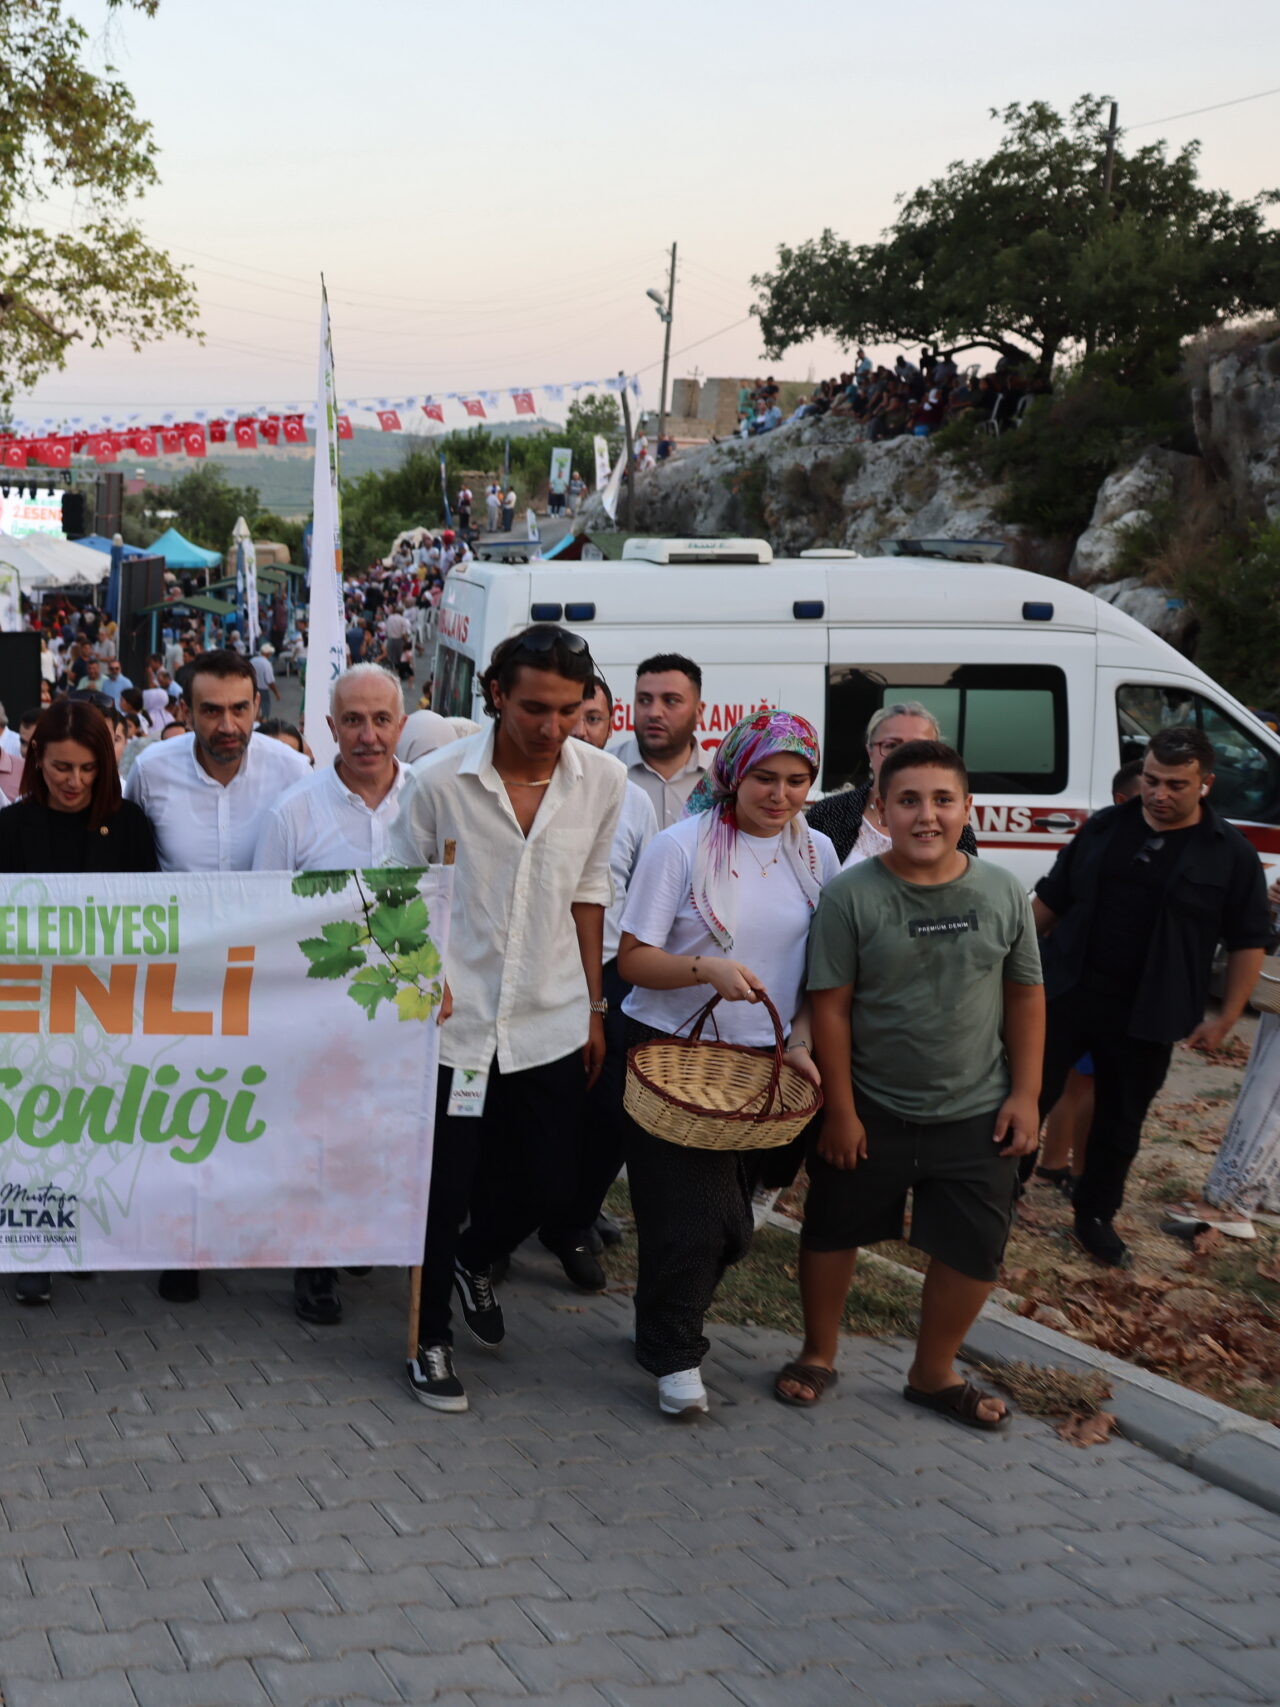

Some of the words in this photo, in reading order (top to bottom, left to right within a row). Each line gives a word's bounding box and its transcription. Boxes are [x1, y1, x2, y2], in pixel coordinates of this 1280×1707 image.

[0, 1181, 79, 1210] Mustafa
[4, 1233, 42, 1244] BELEDİYE
[43, 1234, 78, 1245] BAŞKANI
